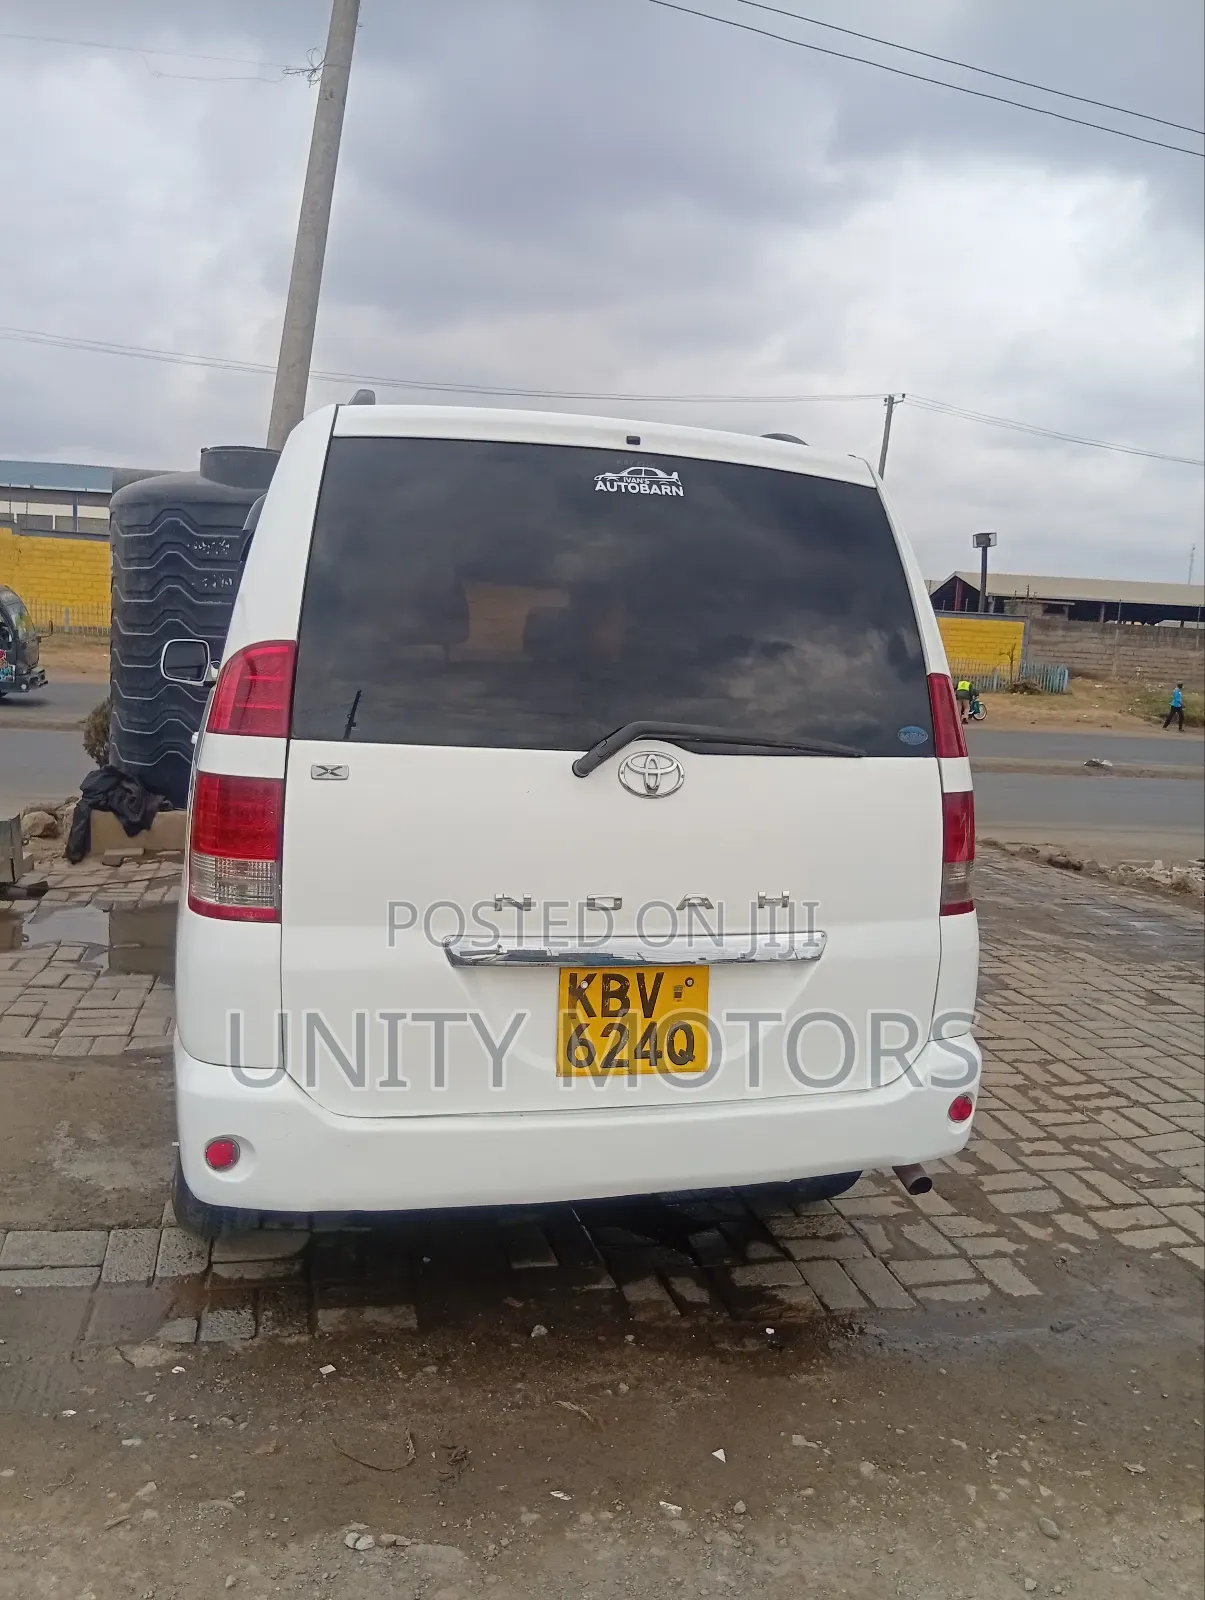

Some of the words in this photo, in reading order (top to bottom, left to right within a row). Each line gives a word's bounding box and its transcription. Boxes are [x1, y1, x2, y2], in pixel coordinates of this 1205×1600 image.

[595, 481, 684, 496] AUTOBARN
[623, 477, 650, 485] IVAN'S
[315, 765, 343, 777] X
[494, 891, 790, 911] NOAH
[568, 972, 665, 1019] KBV
[566, 1021, 696, 1069] 624Q
